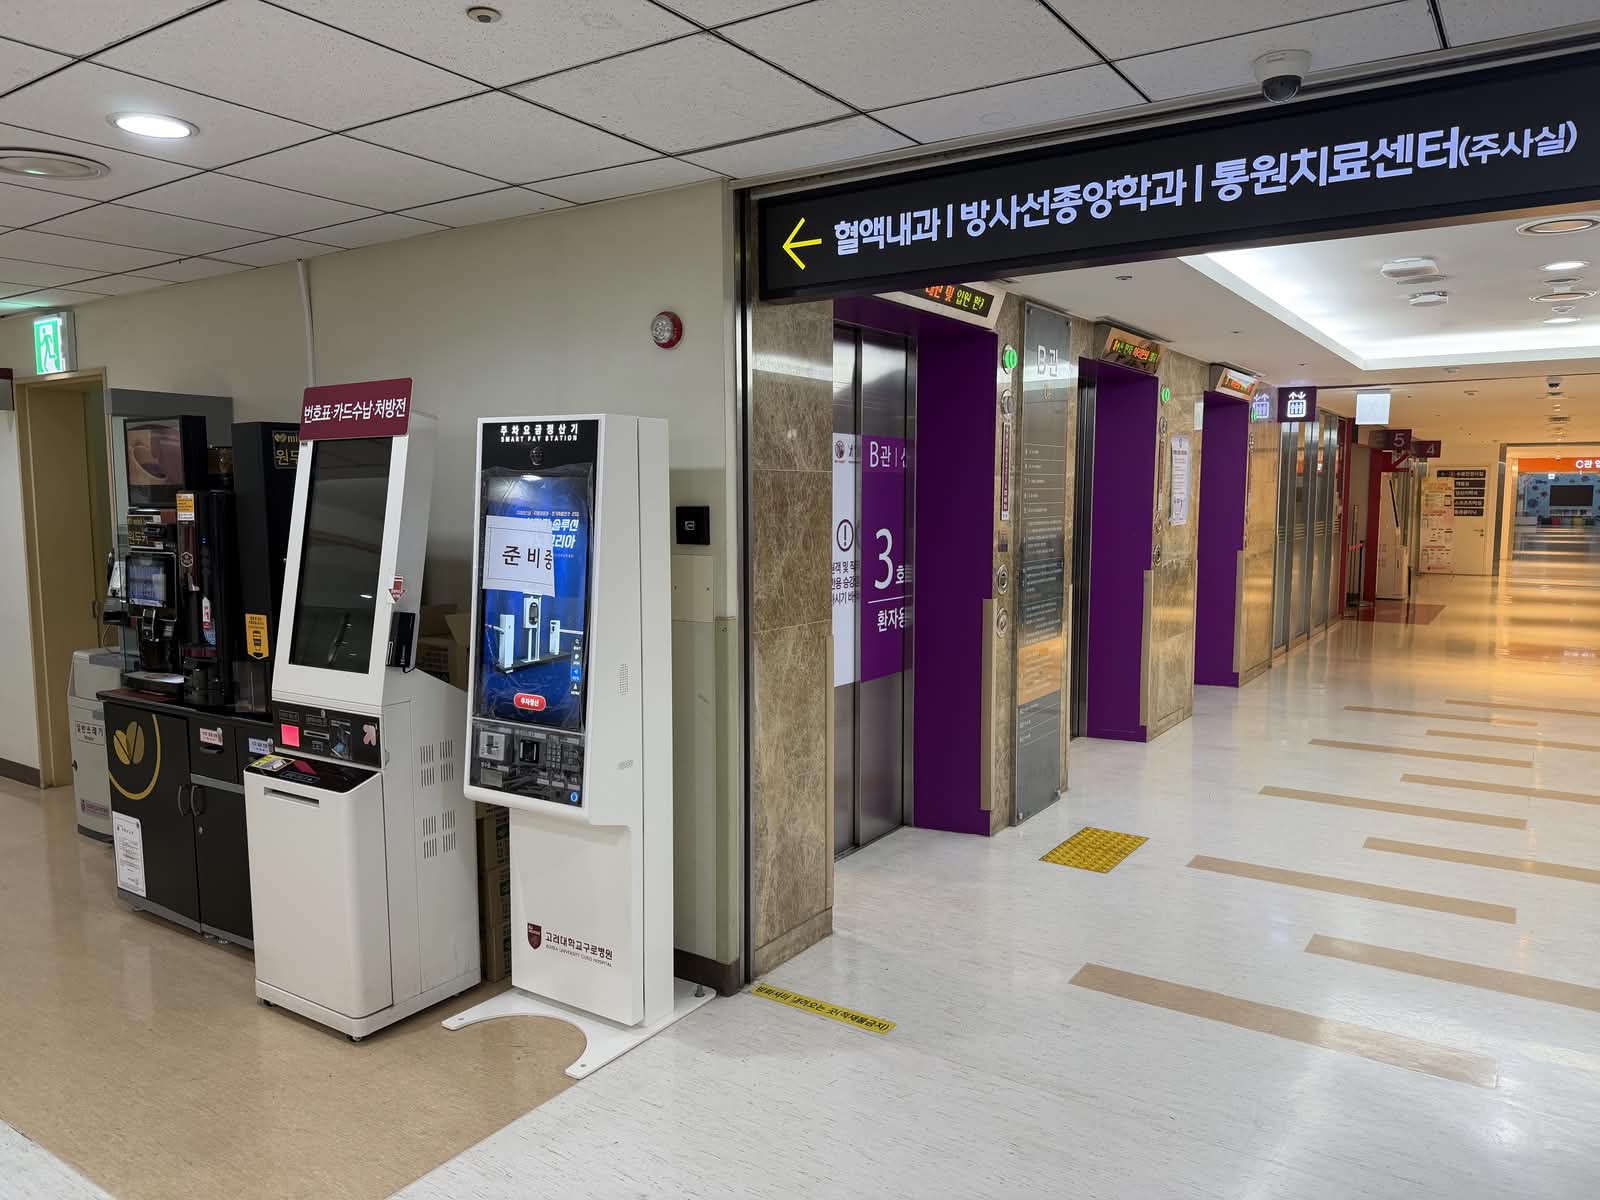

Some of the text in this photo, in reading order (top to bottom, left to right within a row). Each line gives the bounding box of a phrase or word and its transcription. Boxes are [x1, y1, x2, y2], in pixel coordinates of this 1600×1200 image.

[834, 120, 1578, 256] 혈액내과 방사선종양학과 통원치료센터(주사실)
[500, 435, 524, 443] SMART
[545, 434, 578, 442] STATION
[1392, 432, 1405, 447] 5
[869, 440, 892, 468] B관
[545, 932, 613, 961] 고려대학교구로병원
